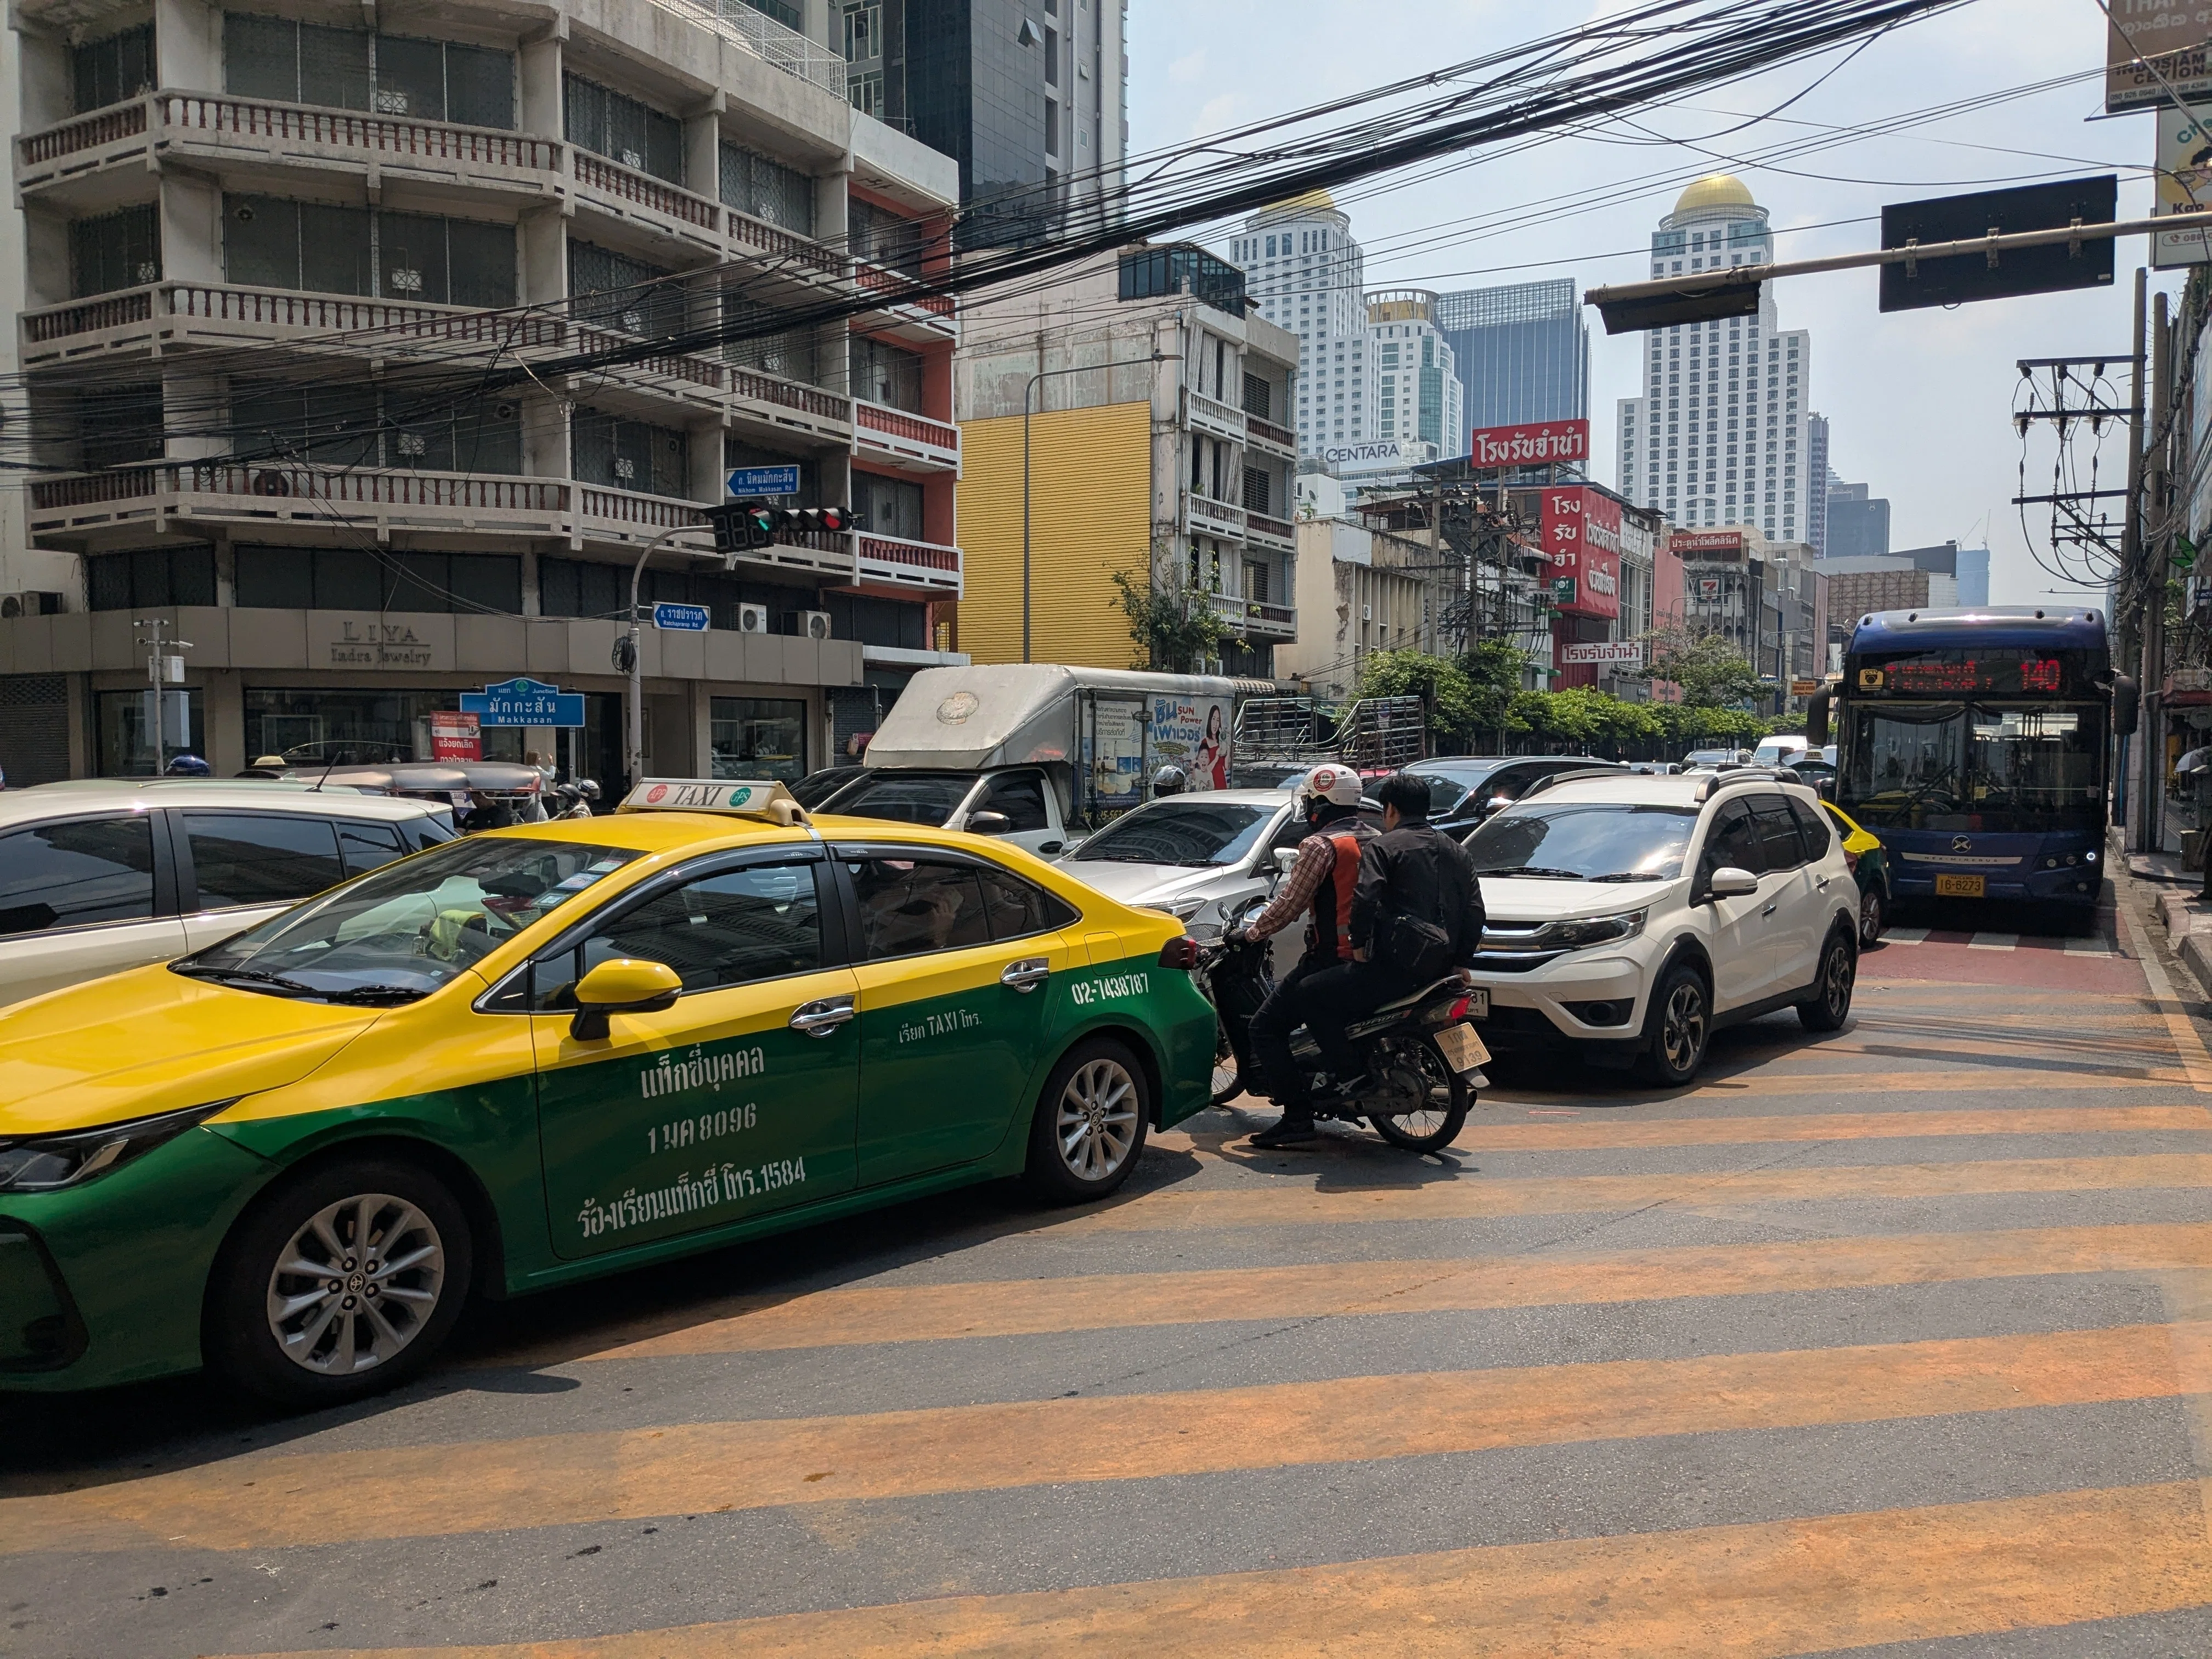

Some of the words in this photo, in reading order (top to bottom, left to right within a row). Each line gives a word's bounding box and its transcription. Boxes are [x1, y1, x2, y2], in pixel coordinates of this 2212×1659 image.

[1325, 443, 1400, 463] CENTARA
[1476, 426, 1582, 463] โรงรับจำนำ
[747, 468, 794, 484] นิคมมักกะสัน
[1551, 495, 1581, 515] โรง
[1553, 523, 1577, 541] รับ
[668, 608, 703, 621] ราชปรารภ
[343, 622, 419, 641] LIYA
[331, 647, 372, 662] Indra
[376, 647, 432, 667] Jewelry
[1564, 642, 1639, 660] โรงรับจำนำ
[489, 696, 556, 713] มักกะสัน
[1177, 706, 1194, 715] SUN
[498, 715, 552, 724] Makkasan
[1180, 715, 1203, 725] Power
[438, 737, 474, 749] แจ้งยกเลิก
[647, 788, 667, 799] APP
[672, 786, 723, 805] TAXI
[730, 791, 750, 803] GPS
[1940, 879, 1981, 891] 16-6273
[1071, 973, 1149, 1005] 02-7438787
[899, 1023, 926, 1043] เรียก
[927, 1011, 958, 1036] TAXI
[959, 1009, 983, 1028] โทร.
[1456, 1050, 1482, 1066] 9139
[641, 1043, 764, 1098] แท็กซี่บุคคล
[700, 1103, 757, 1141] 8096
